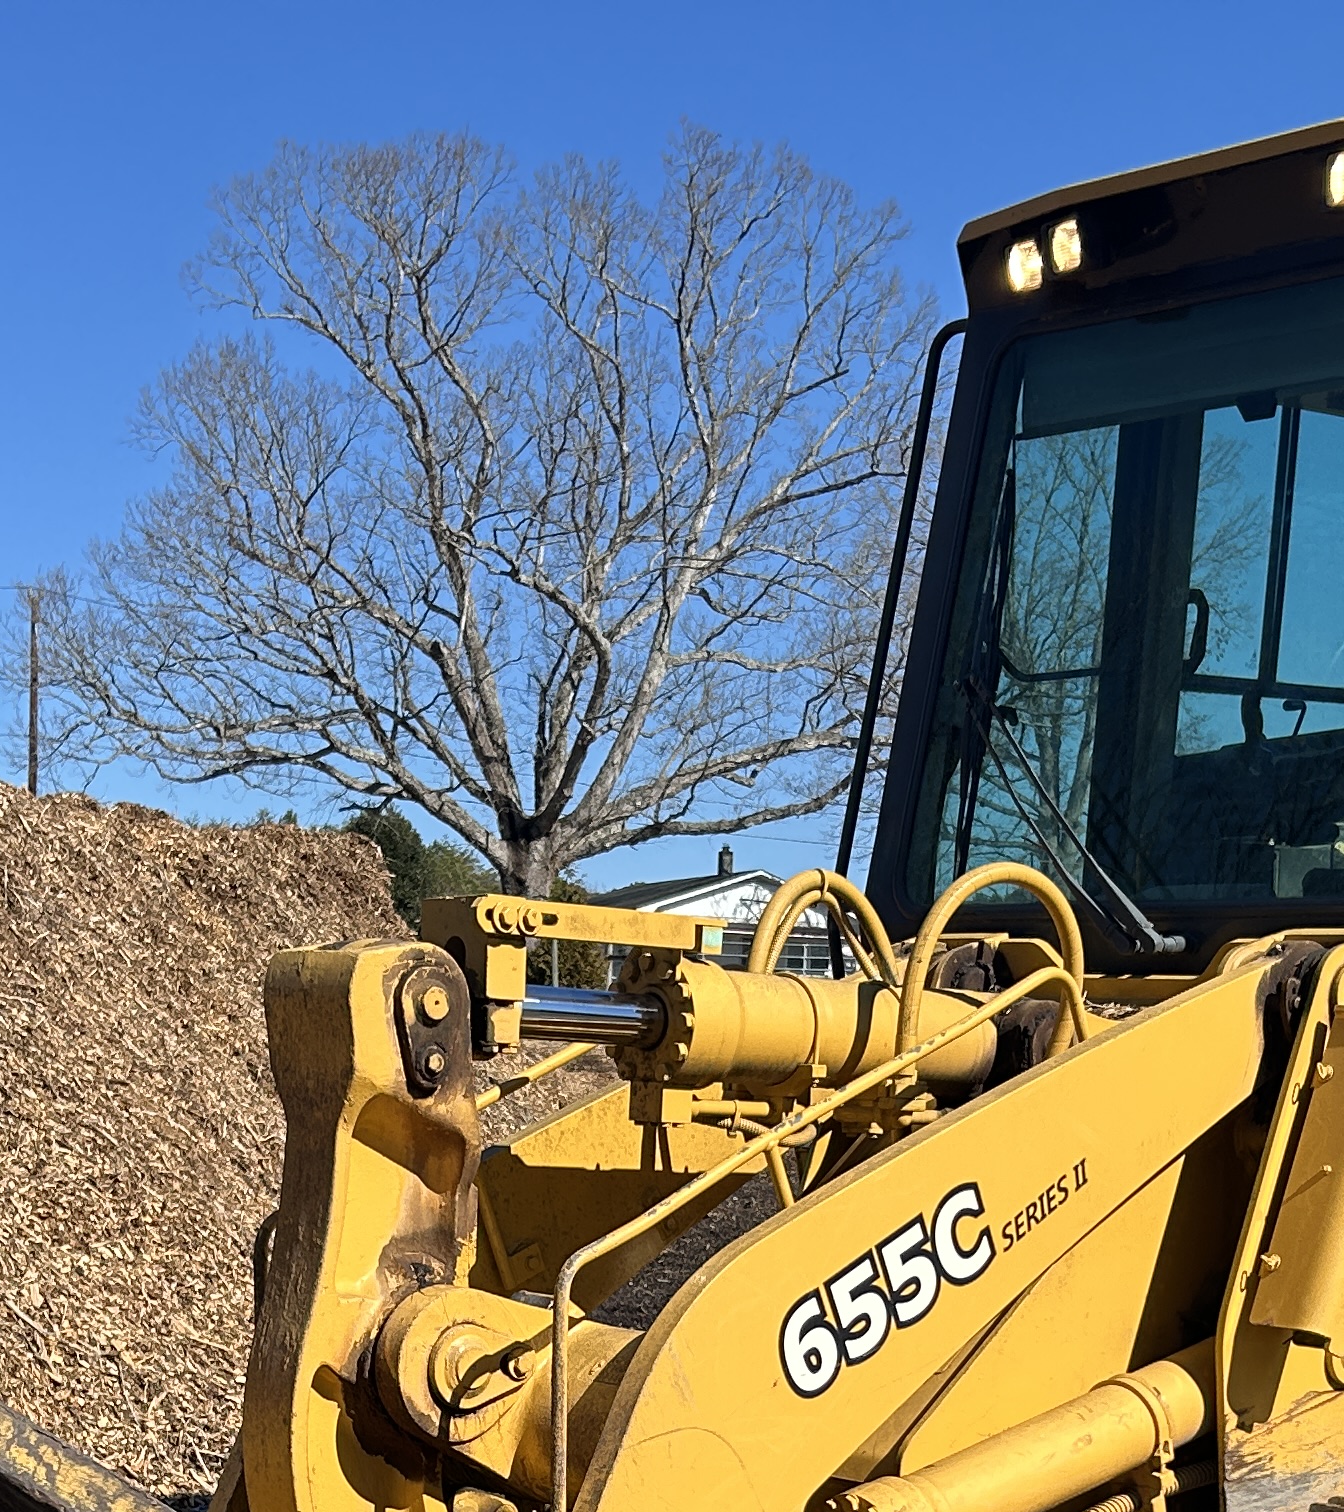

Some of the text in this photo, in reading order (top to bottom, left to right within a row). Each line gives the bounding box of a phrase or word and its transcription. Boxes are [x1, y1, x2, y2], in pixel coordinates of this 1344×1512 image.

[779, 1156, 1089, 1399] 655C SERIES II
